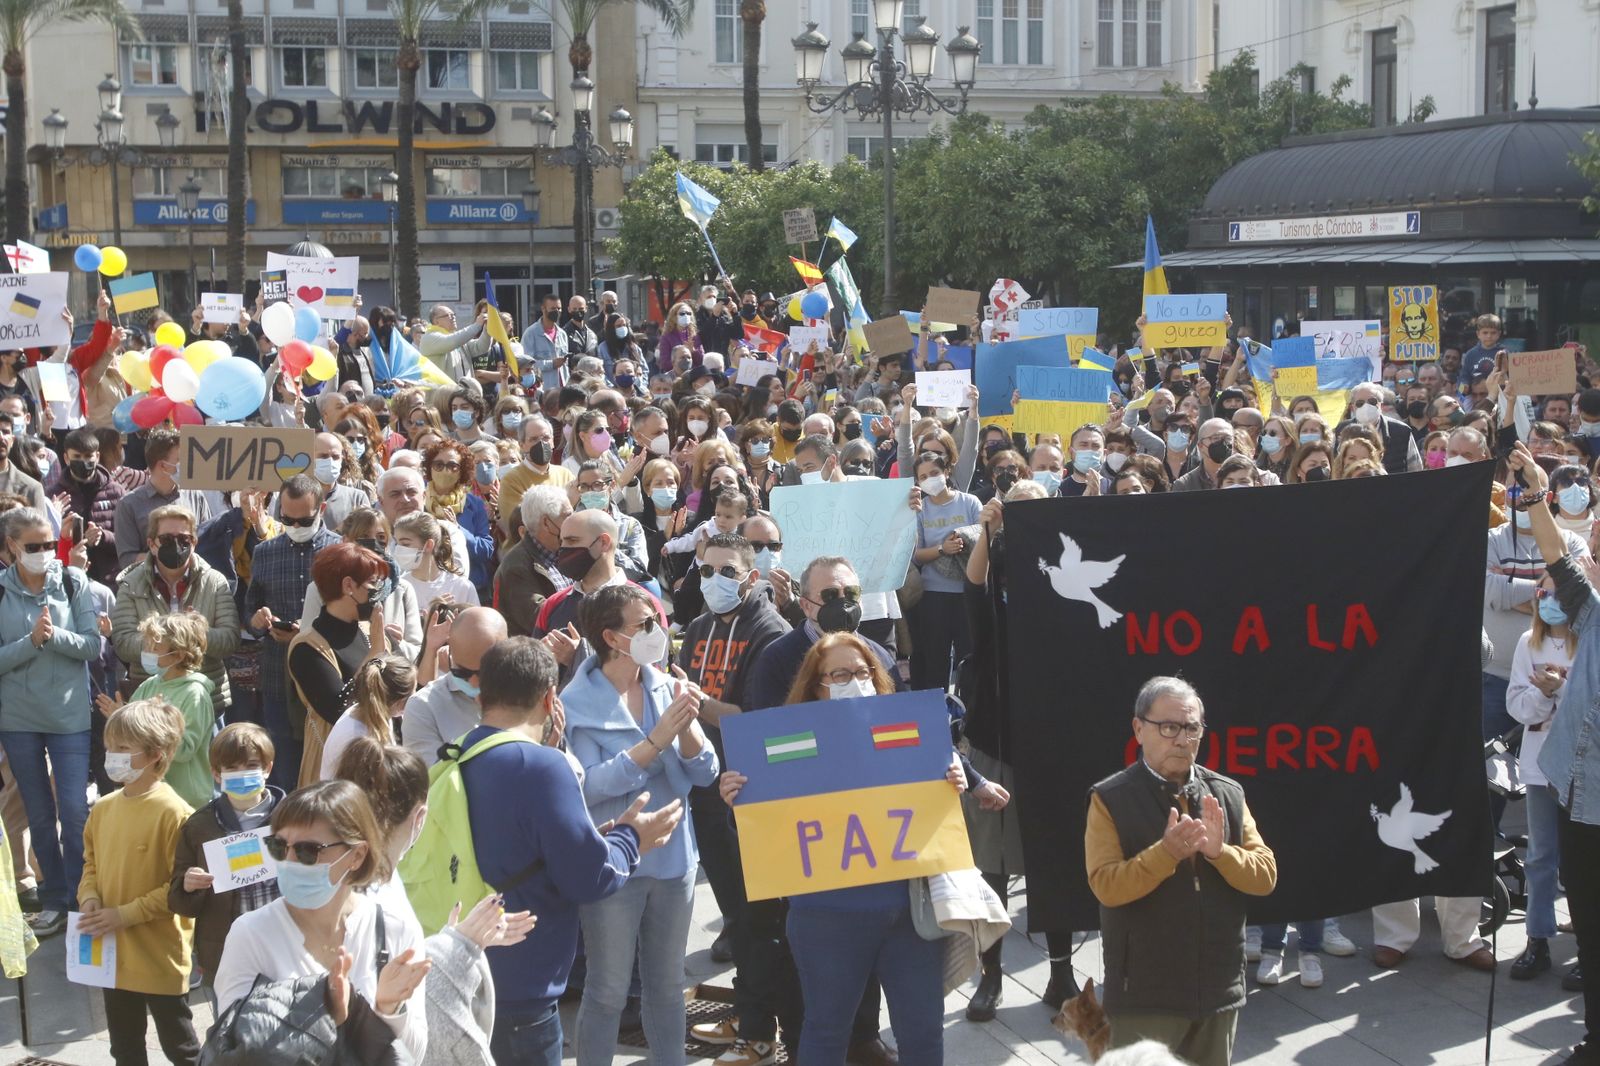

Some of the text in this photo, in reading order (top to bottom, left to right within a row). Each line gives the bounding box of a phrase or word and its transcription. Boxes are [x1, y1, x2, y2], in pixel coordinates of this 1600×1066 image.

[450, 204, 496, 218] Allianz
[1279, 221, 1311, 239] Turismo
[1312, 219, 1324, 236] de
[1325, 215, 1363, 236] Córdoba
[263, 281, 286, 294] НЕТ
[1393, 286, 1433, 306] STOP
[1155, 297, 1212, 319] No a la
[1396, 342, 1436, 358] PUTIN
[1020, 368, 1049, 397] NO
[187, 436, 285, 481] МИР
[1125, 602, 1380, 656] NO A LA
[1125, 722, 1381, 776] ERRA
[797, 808, 919, 878] PAZ
